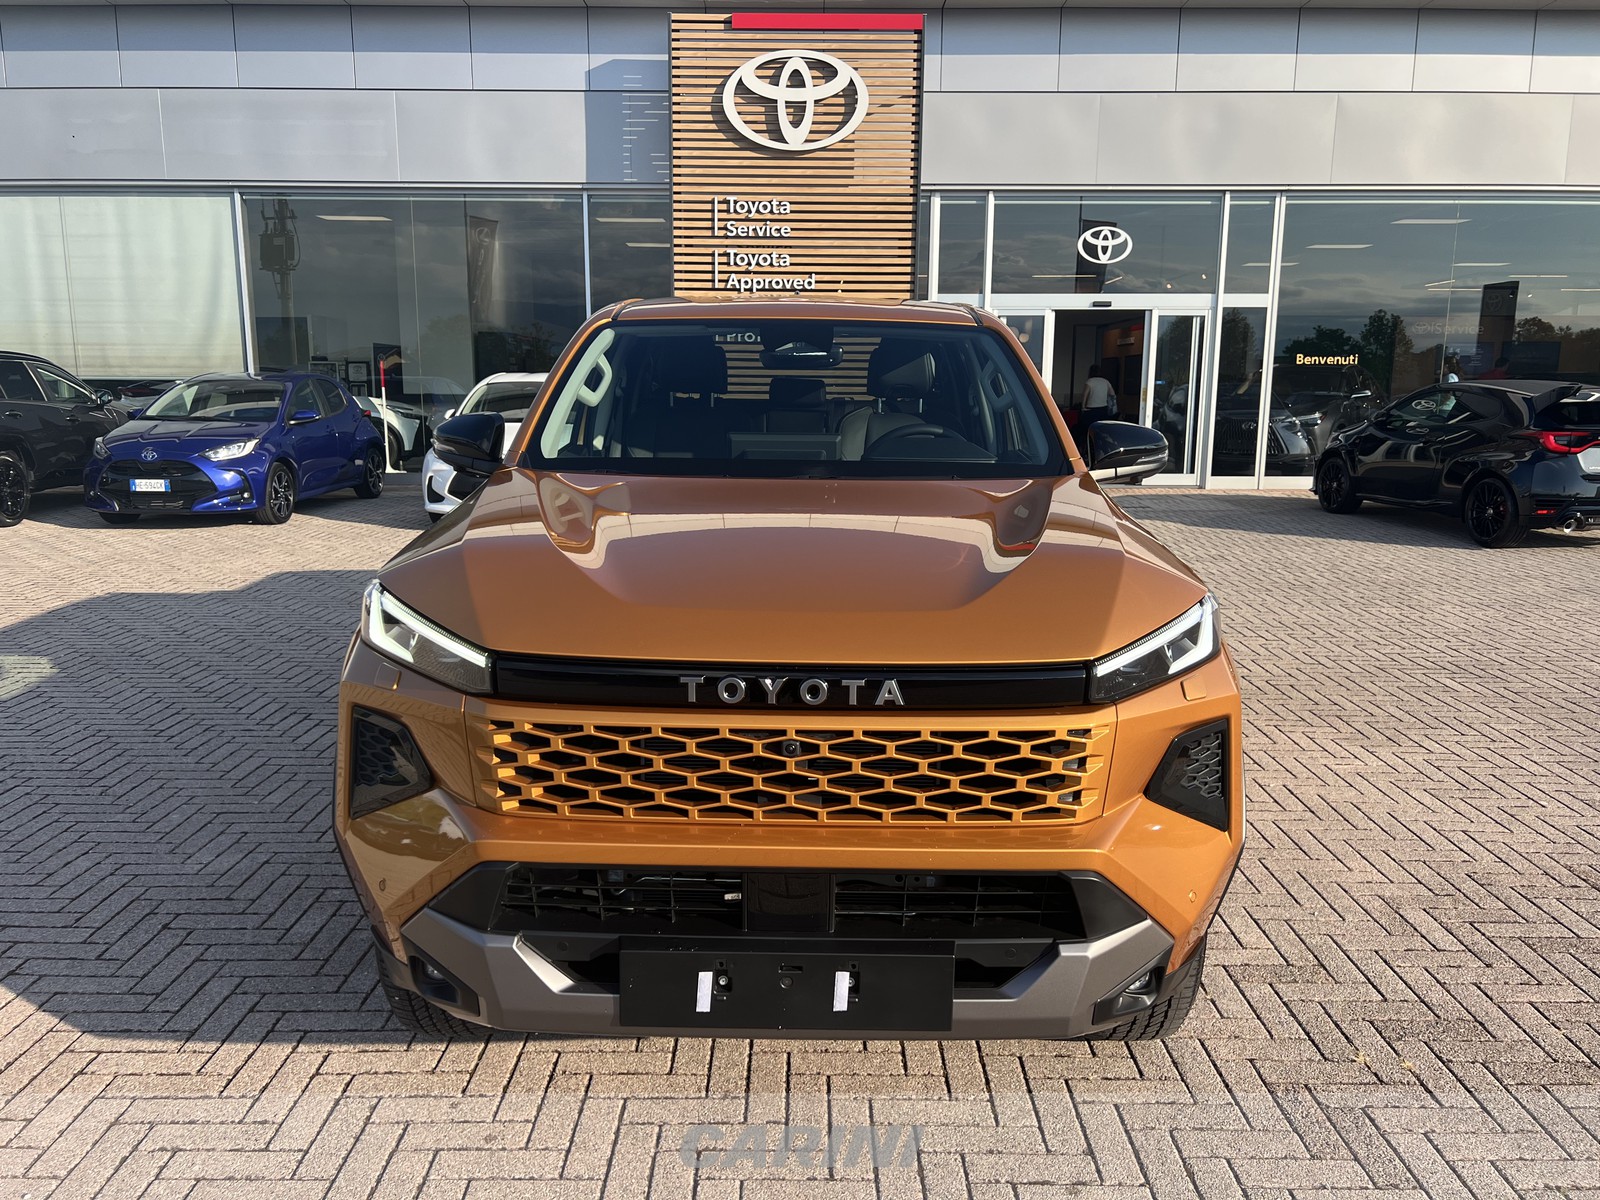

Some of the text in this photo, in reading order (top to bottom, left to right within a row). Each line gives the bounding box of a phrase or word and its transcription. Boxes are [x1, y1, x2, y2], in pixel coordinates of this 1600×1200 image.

[726, 196, 791, 218] Toyota
[726, 221, 791, 237] Service
[726, 250, 791, 270] Toyota
[726, 273, 816, 293] Approved
[1295, 353, 1359, 366] Benvenuti
[679, 675, 905, 706] TOYOTA
